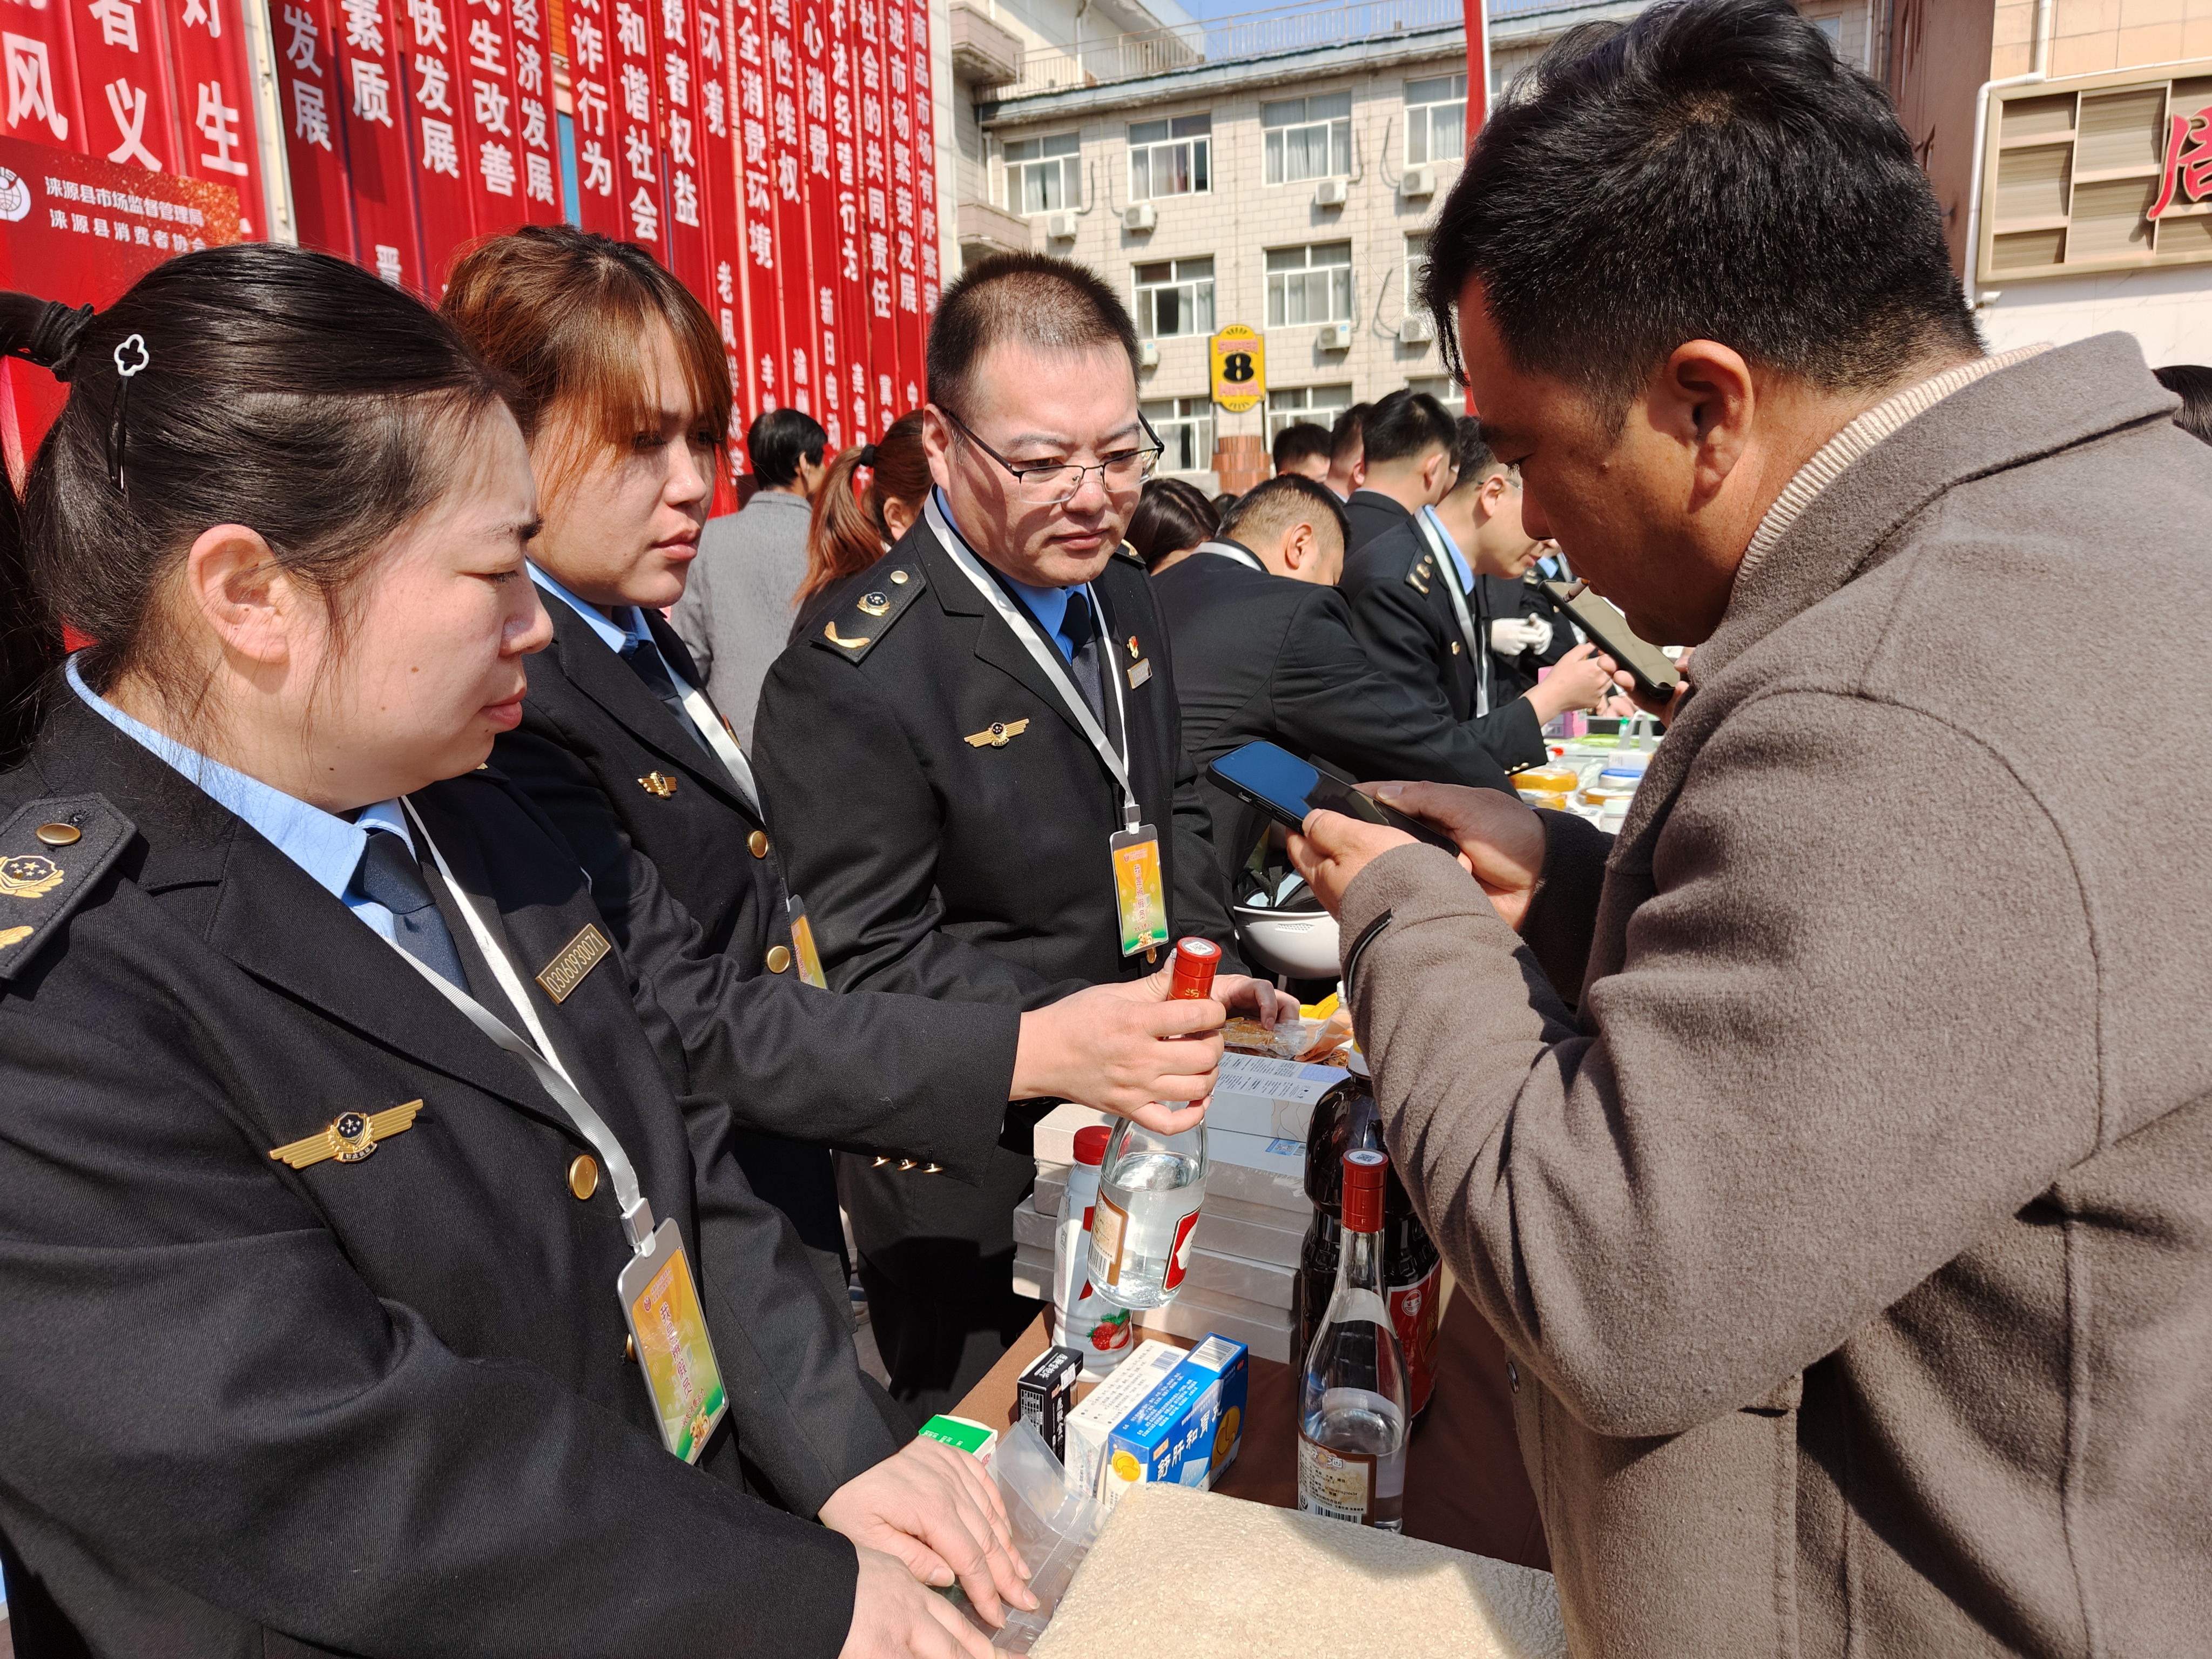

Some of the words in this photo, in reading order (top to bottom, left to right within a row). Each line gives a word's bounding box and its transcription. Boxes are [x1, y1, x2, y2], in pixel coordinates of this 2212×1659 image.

[2, 31, 69, 141] 风
[284, 4, 332, 152] 发展
[341, 0, 394, 128] 素质
[408, 0, 460, 179] 快发展
[467, 0, 516, 197] 生改善
[512, 0, 555, 206] 经济发展
[571, 0, 612, 197] 诈行为
[616, 2, 658, 242] 和谐社会
[698, 9, 726, 138] 环境
[802, 6, 830, 180] 心消费
[737, 0, 773, 269] 全消费环境
[859, 0, 891, 319] 社会的共同责任
[44, 176, 205, 227] 涞源县市场监督管理局
[49, 208, 207, 252] 涞源县消费者协会
[819, 286, 841, 463] 新日电动
[1217, 340, 1259, 355] SUPER
[1223, 353, 1255, 382] 8
[546, 932, 603, 993] 03060930071
[1137, 931, 1154, 948] 315
[690, 1406, 712, 1449] 315
[1157, 1399, 1223, 1482] 舒肝和胃丸
